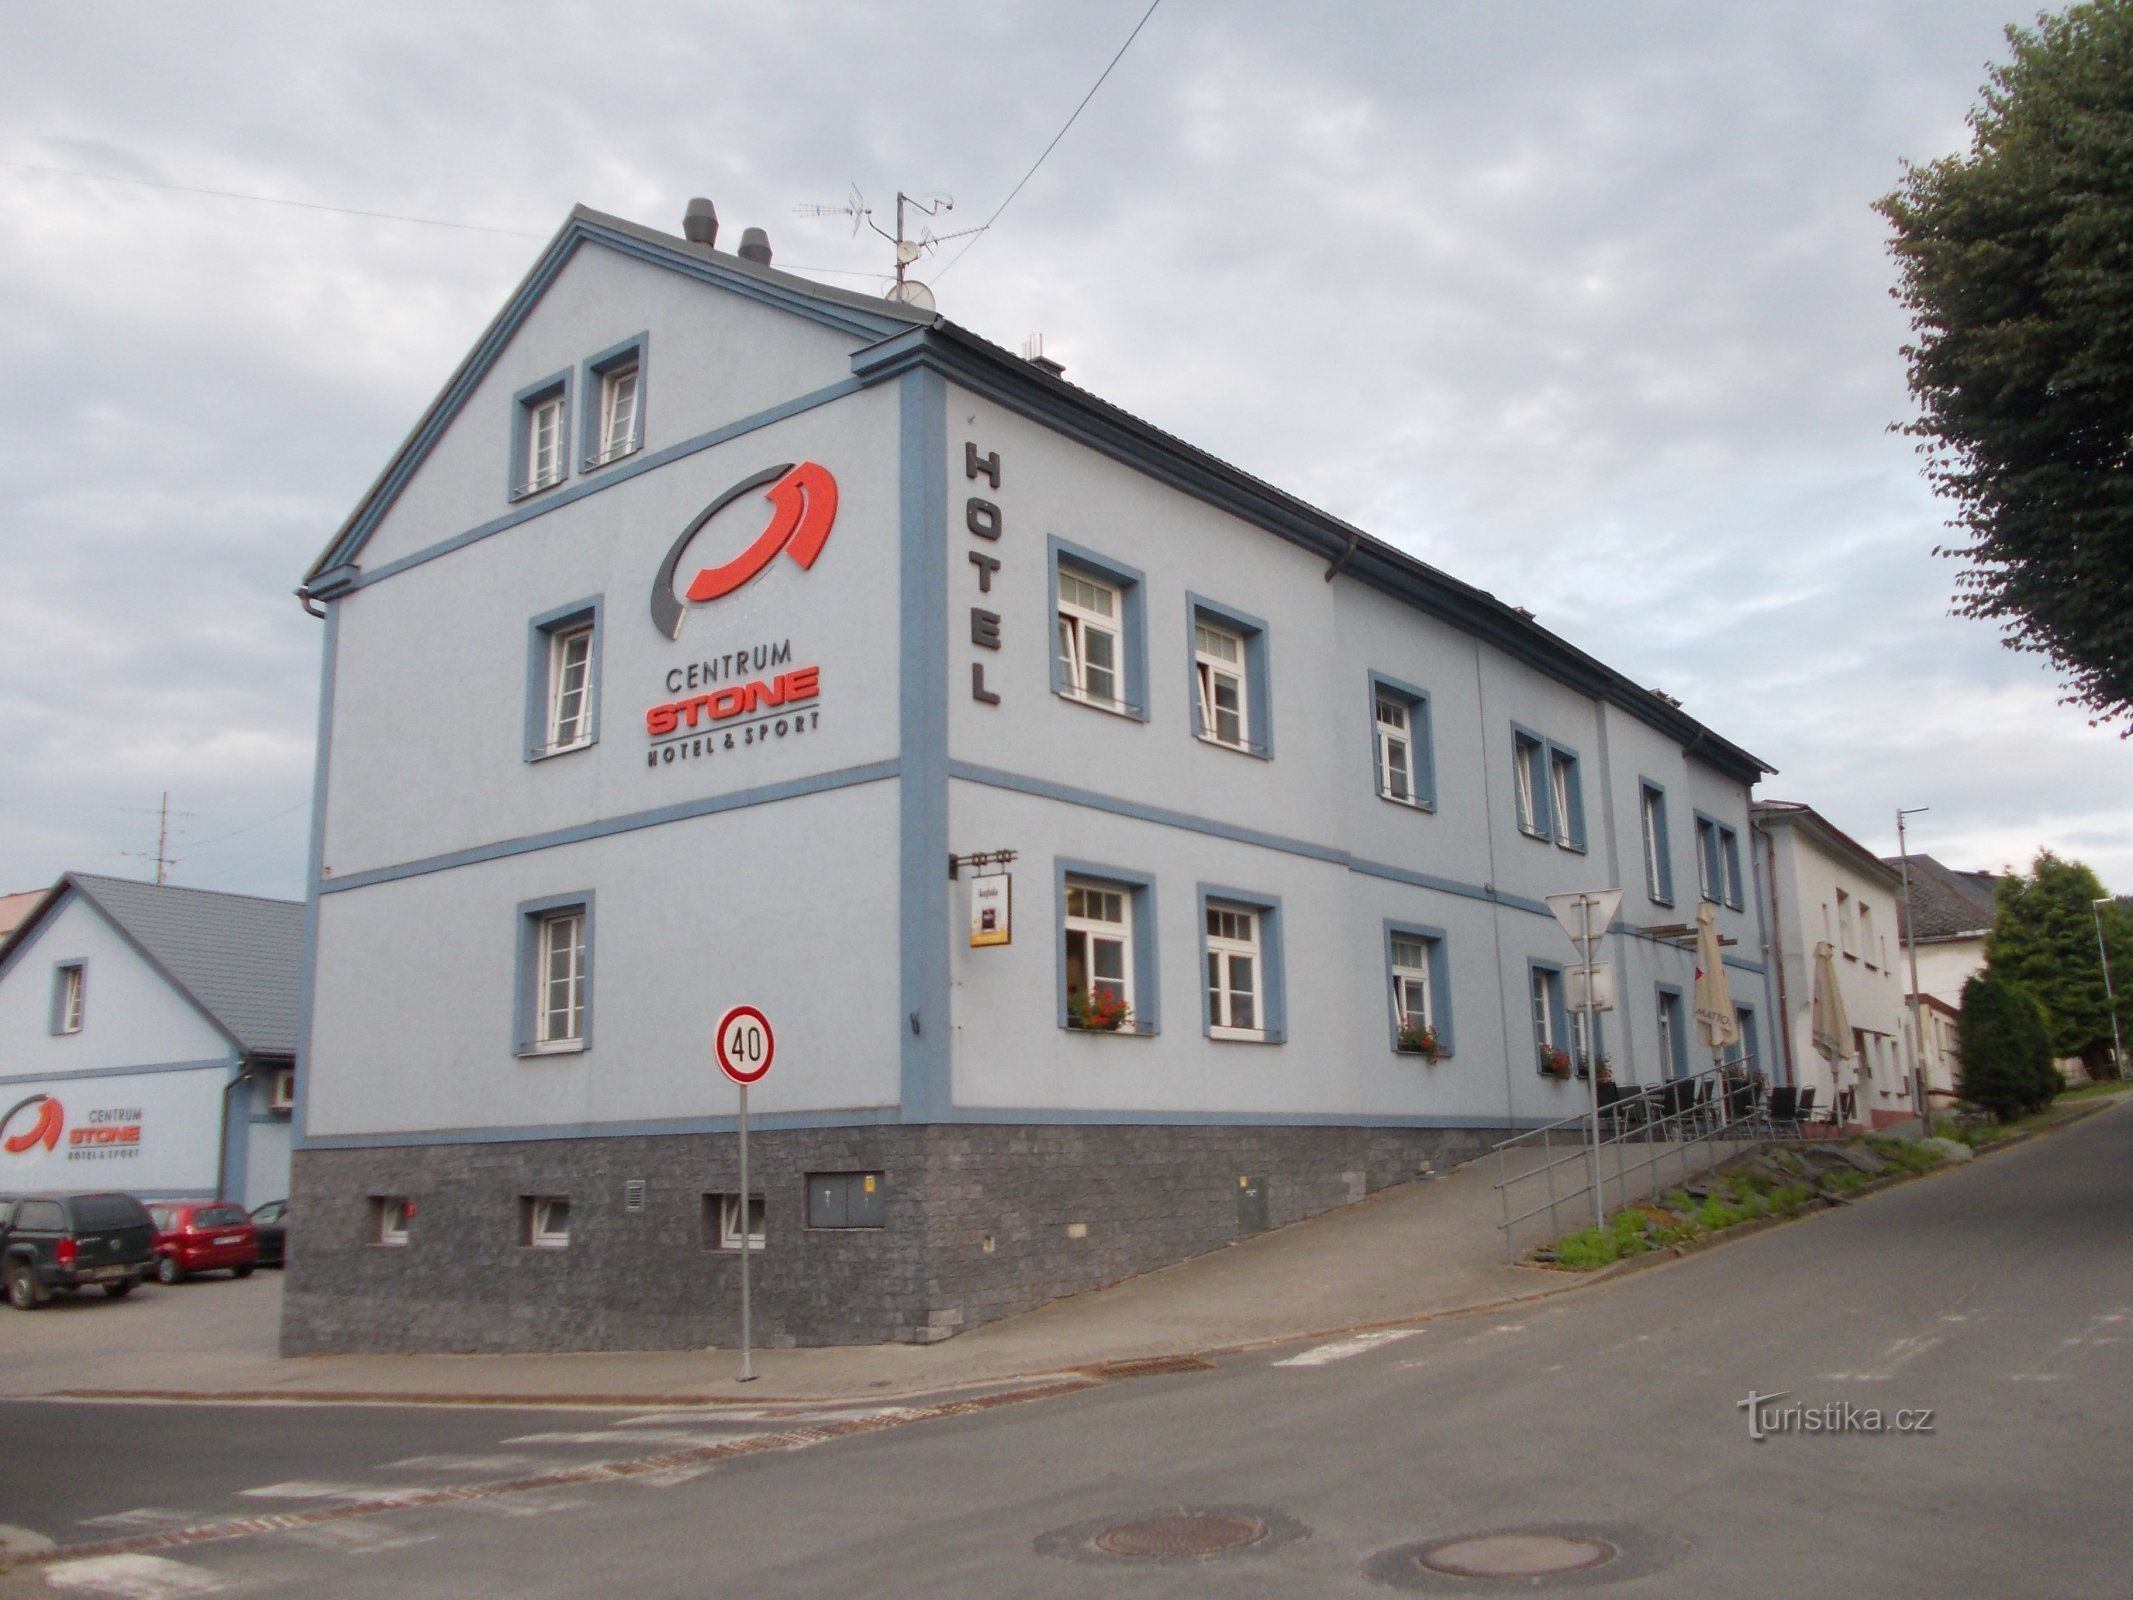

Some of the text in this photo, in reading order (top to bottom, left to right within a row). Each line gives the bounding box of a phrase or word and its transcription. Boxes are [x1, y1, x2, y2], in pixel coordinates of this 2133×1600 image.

[965, 441, 1002, 706] HOTEL
[665, 638, 792, 693] CENTRUM
[646, 665, 820, 736] STONE
[647, 711, 819, 767] HOTEL & SPORT
[731, 1026, 761, 1062] 40
[68, 1125, 141, 1145] STONE
[88, 1107, 142, 1124] CENTRUM
